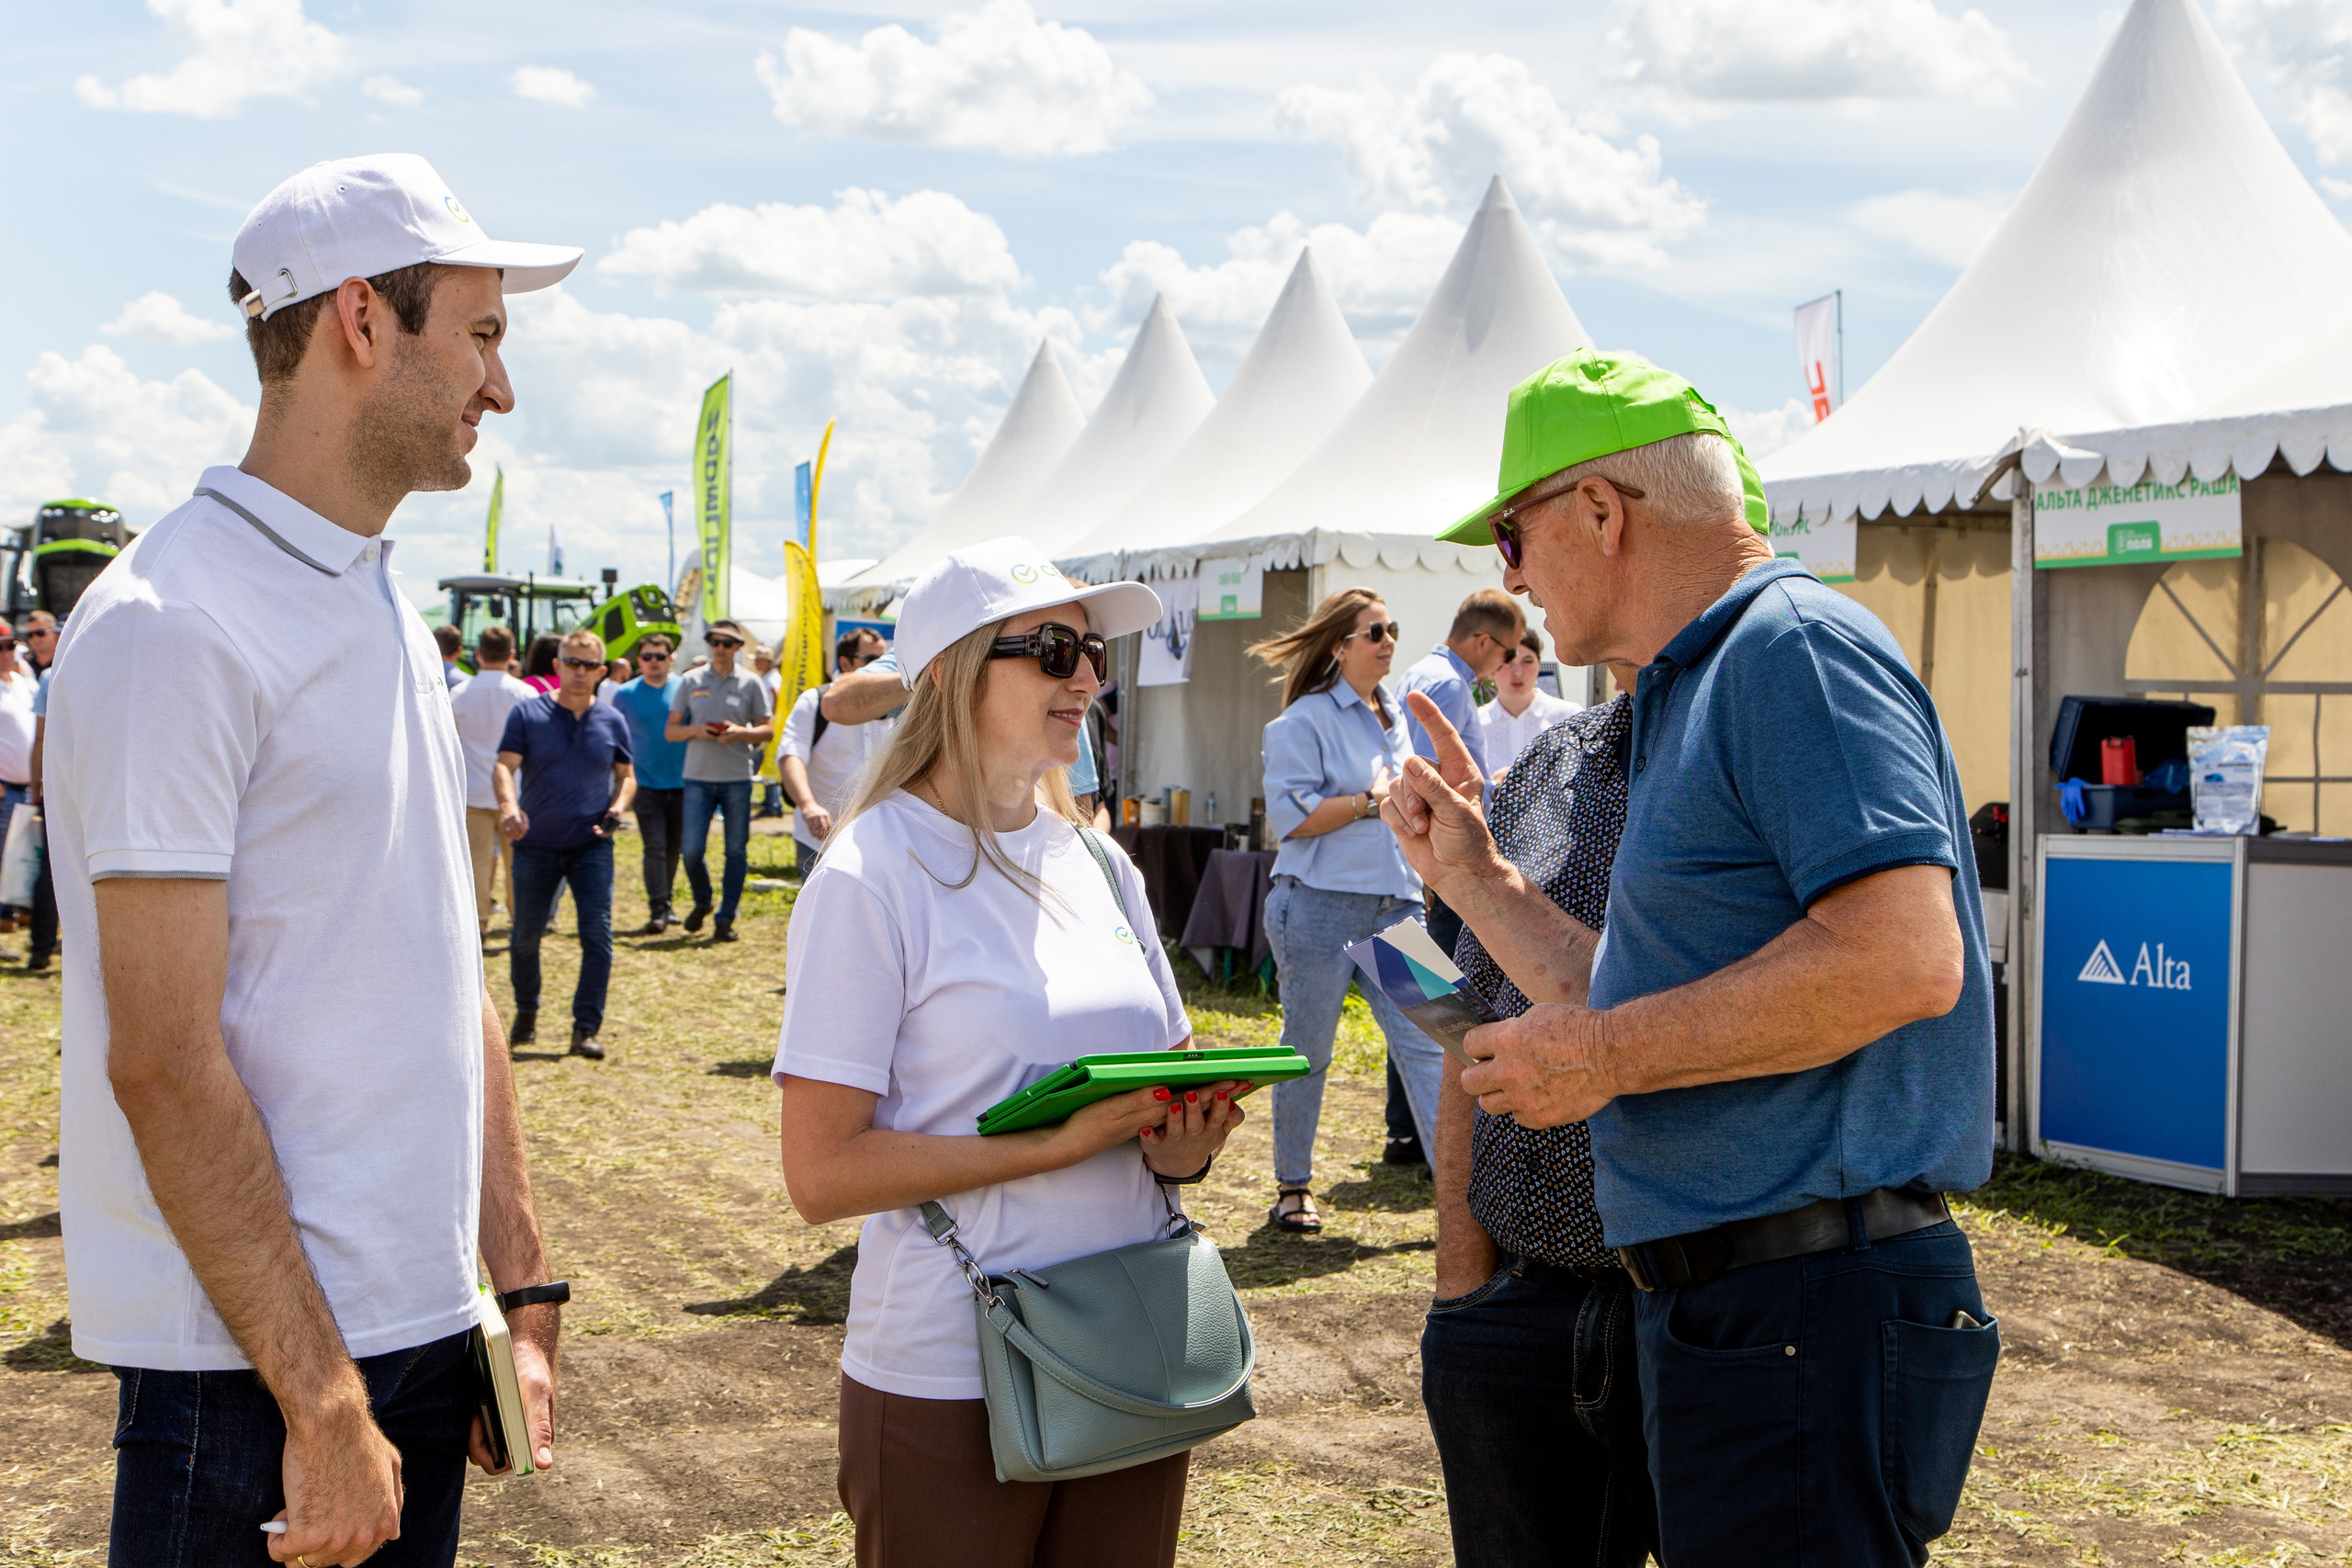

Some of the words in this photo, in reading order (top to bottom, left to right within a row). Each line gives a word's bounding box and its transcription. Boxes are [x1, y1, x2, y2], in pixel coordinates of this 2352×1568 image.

[2035, 489, 2083, 511] АЛЬТА
[2086, 480, 2186, 511] ДЖЕНЕТИКС
[2189, 473, 2240, 497] РАША
[2129, 942, 2192, 990] Alta
